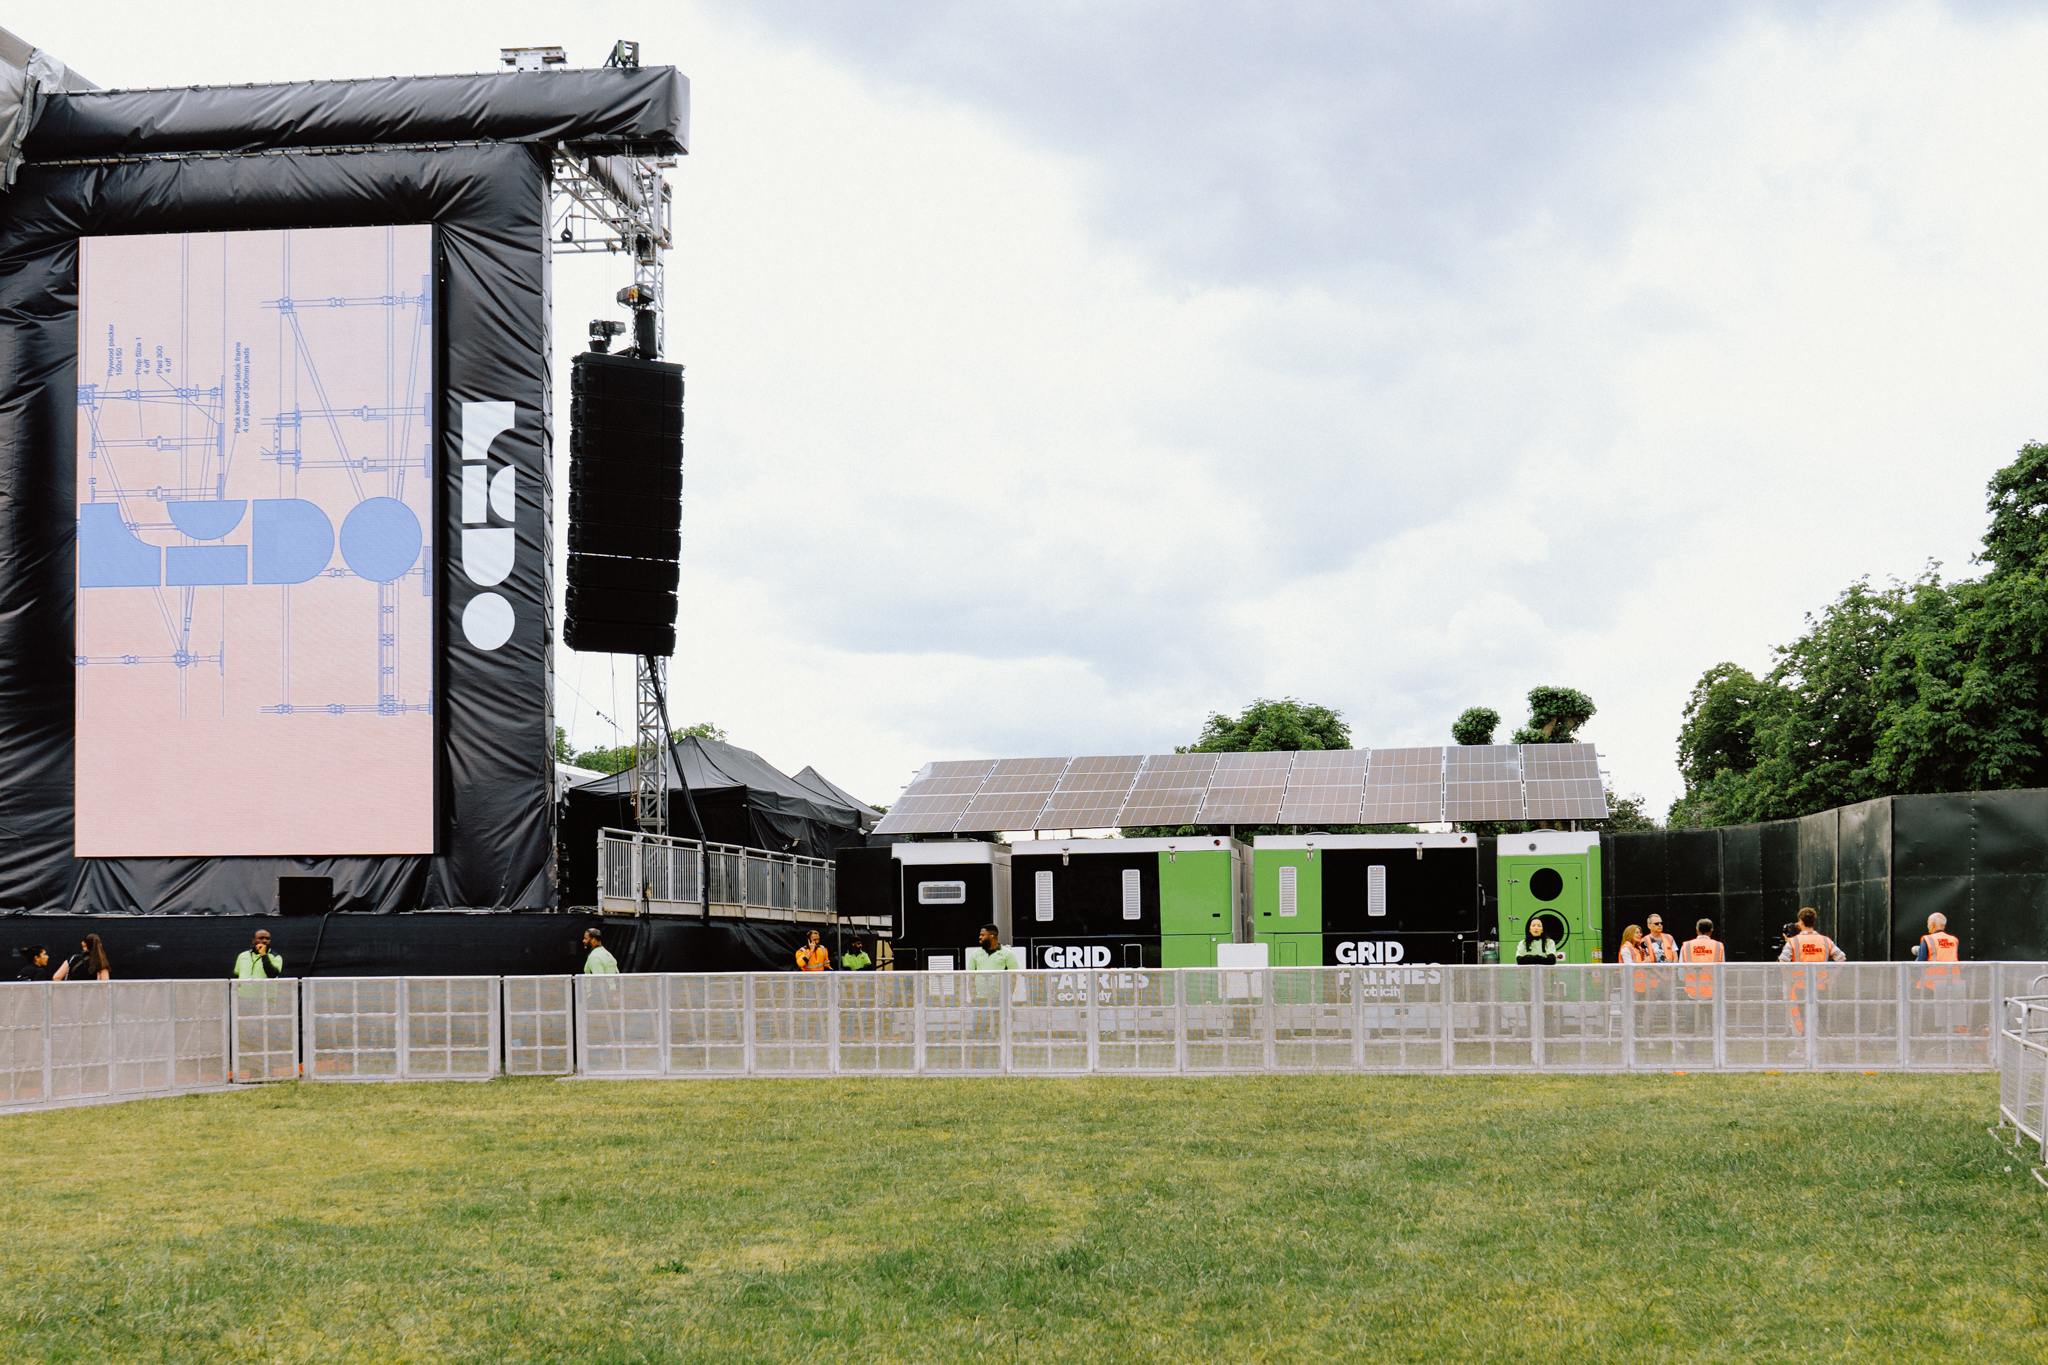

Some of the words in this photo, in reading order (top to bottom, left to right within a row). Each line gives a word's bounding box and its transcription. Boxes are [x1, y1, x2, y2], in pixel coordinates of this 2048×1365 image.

[135, 358, 143, 375] Prop
[1044, 945, 1112, 968] GRID
[1335, 941, 1405, 964] GRID
